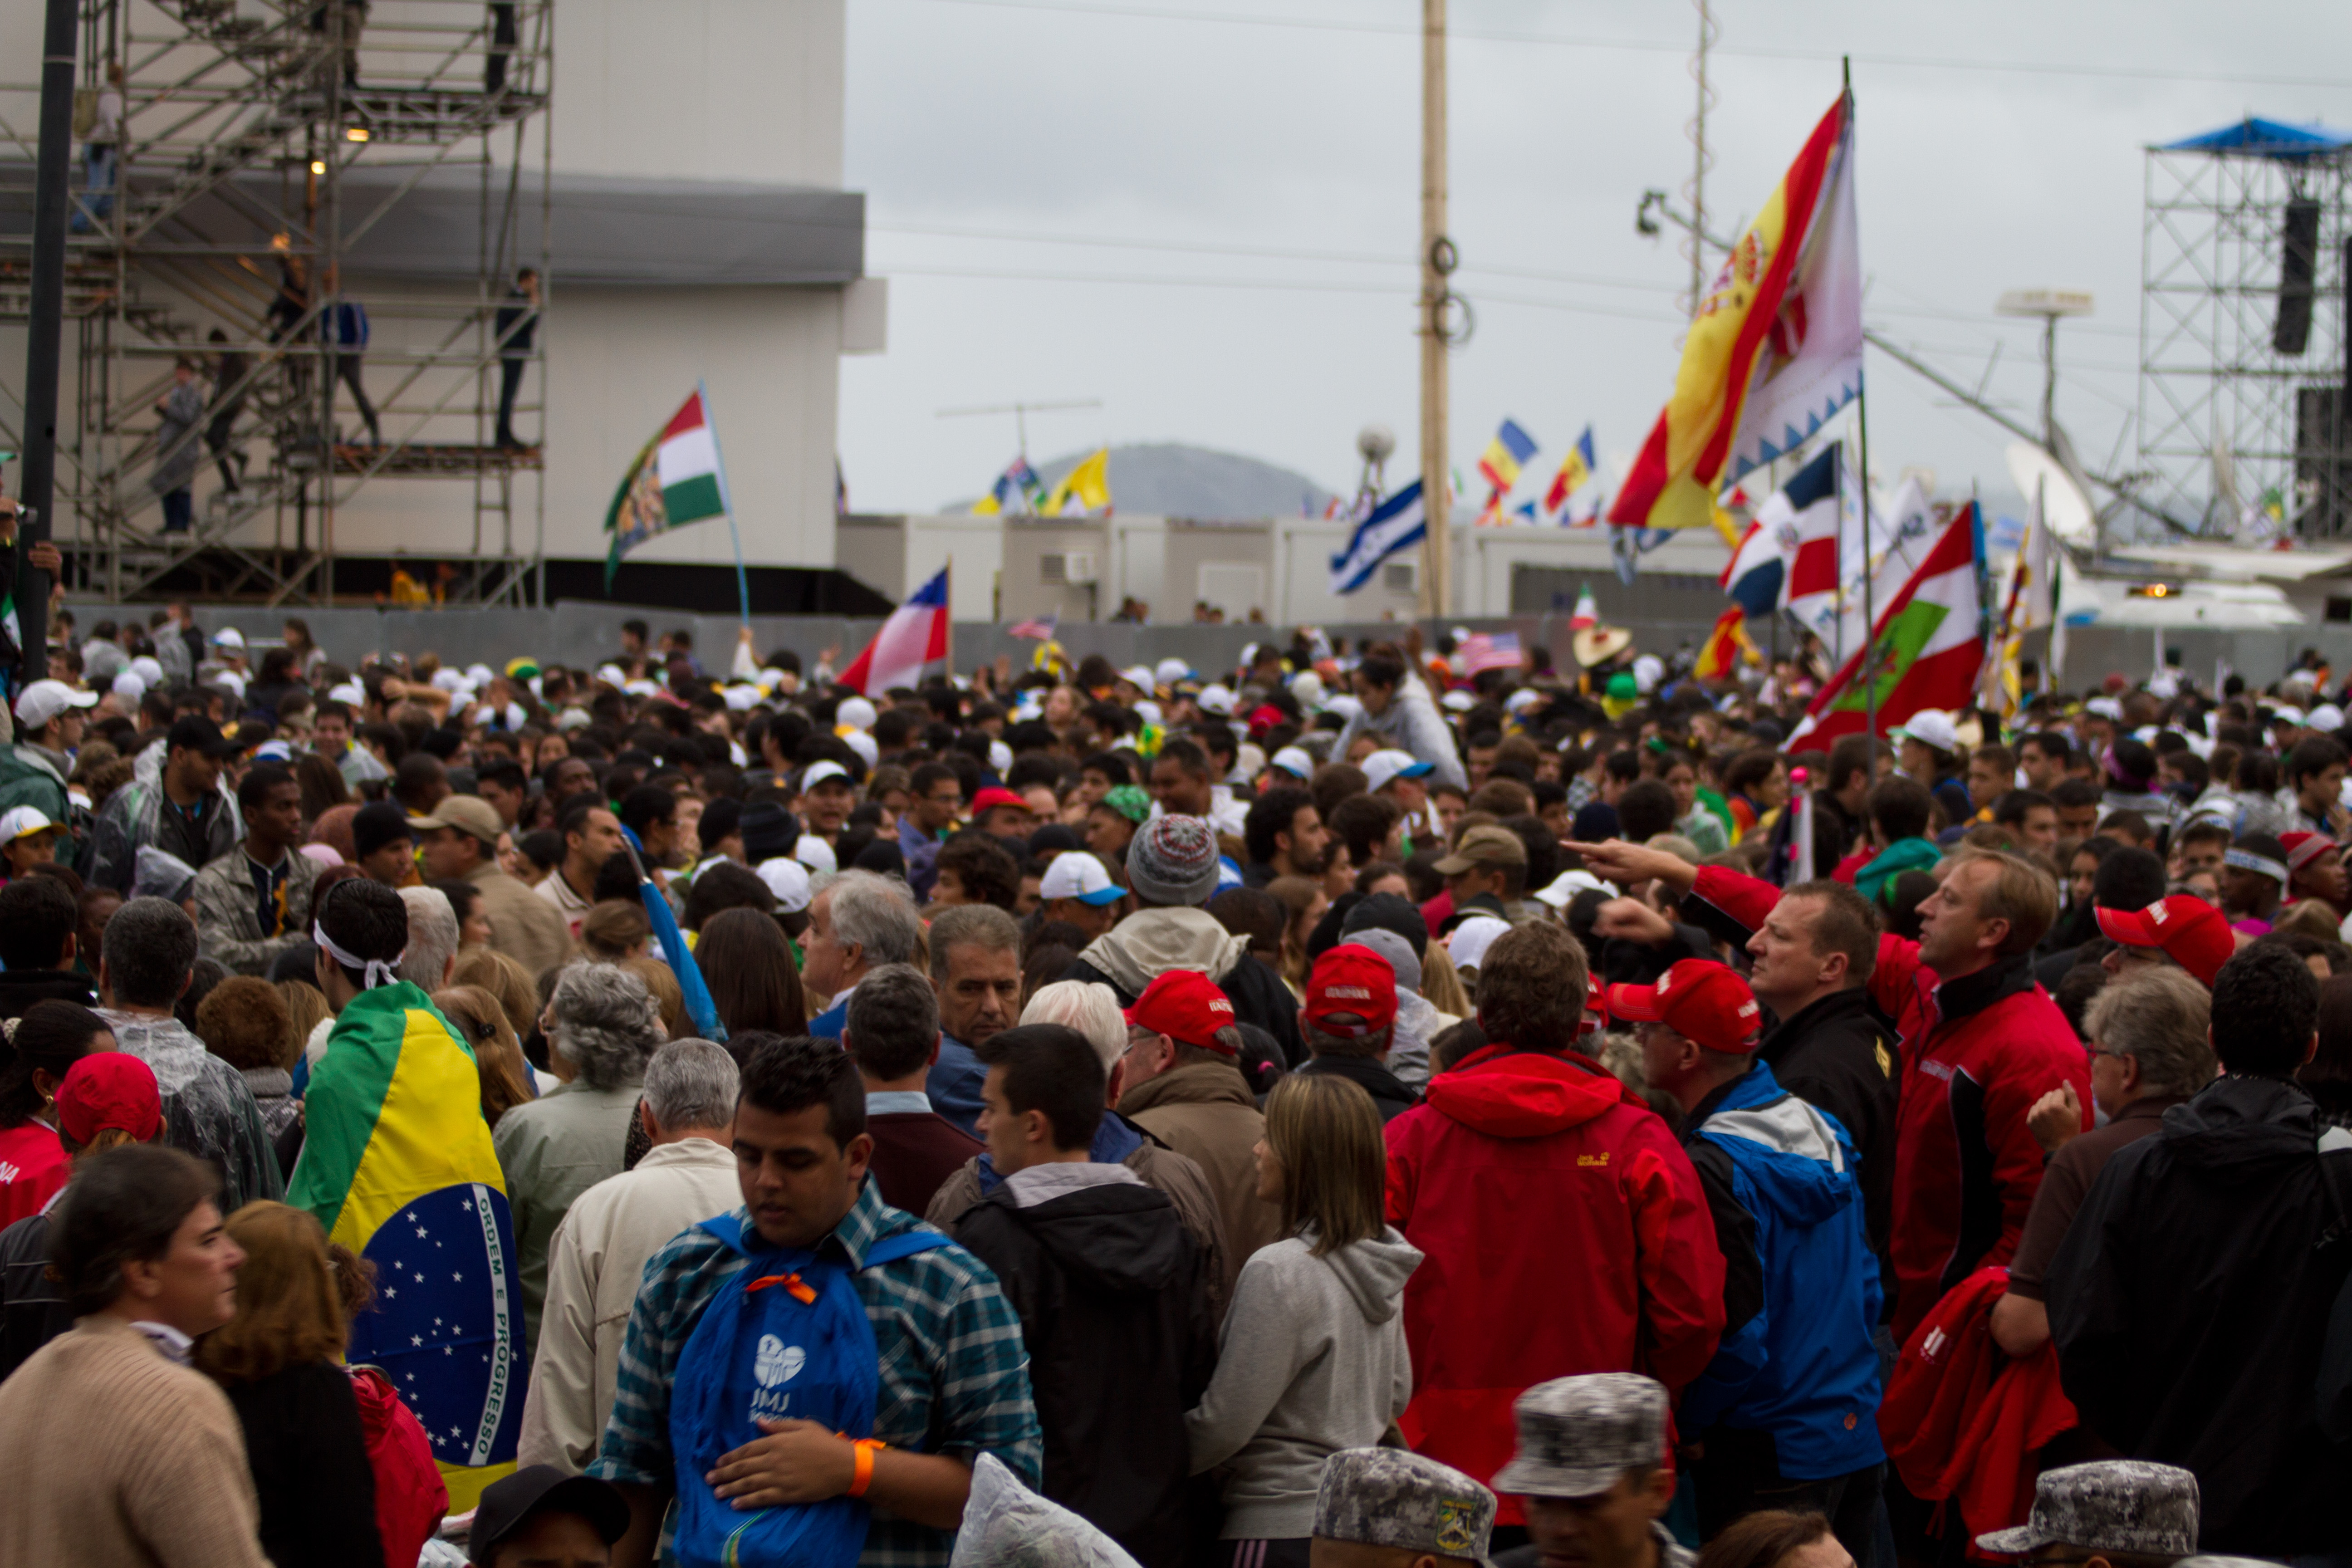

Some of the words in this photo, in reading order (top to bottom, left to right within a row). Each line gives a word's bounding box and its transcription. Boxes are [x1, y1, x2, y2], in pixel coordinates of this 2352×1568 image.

[480, 1199, 502, 1276] ORDEM
[495, 1288, 505, 1300] E
[478, 1313, 508, 1454] PROGRESSO
[750, 1387, 790, 1413] JMJ
